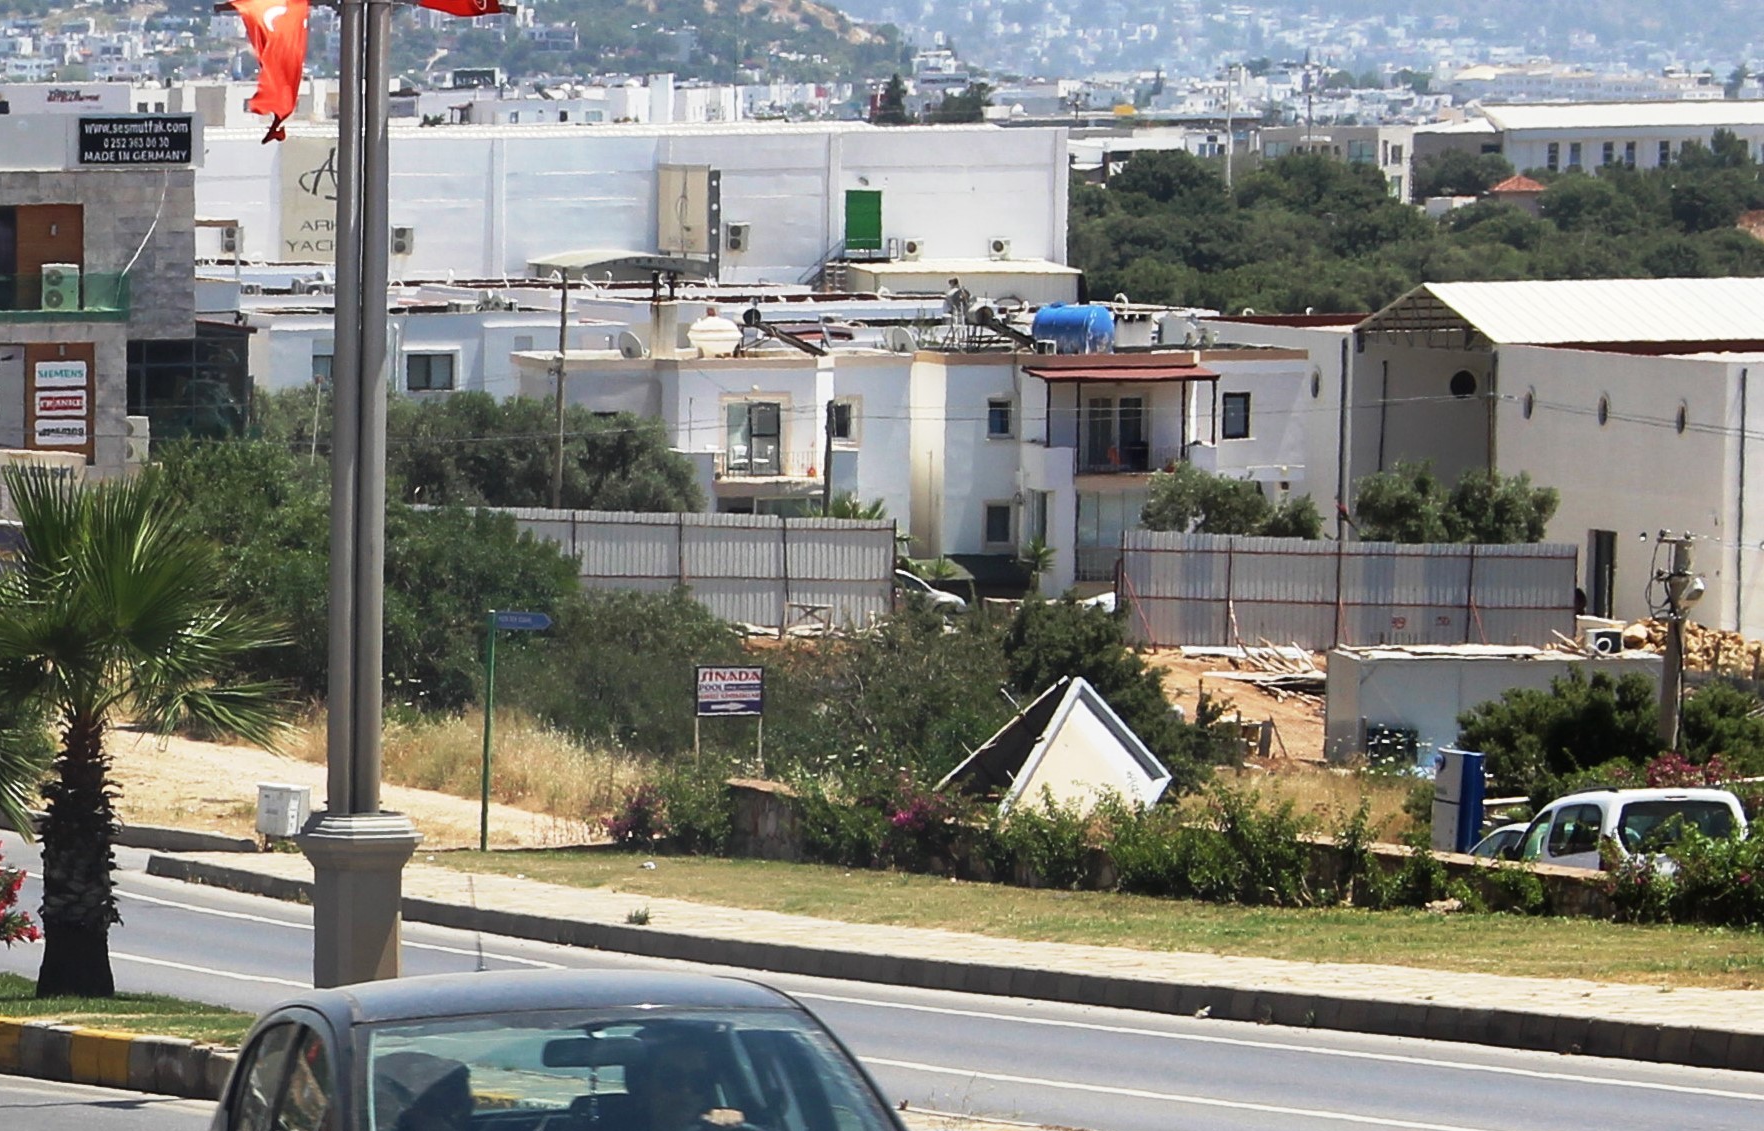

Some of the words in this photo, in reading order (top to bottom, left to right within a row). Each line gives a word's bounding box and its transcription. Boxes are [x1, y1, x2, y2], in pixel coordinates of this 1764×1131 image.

[85, 121, 188, 134] www.sesmutfak.com
[111, 138, 126, 149] 252
[84, 152, 116, 161] MADE
[118, 151, 130, 161] IN
[132, 150, 188, 161] GERMANY
[38, 369, 84, 378] SIEMENS
